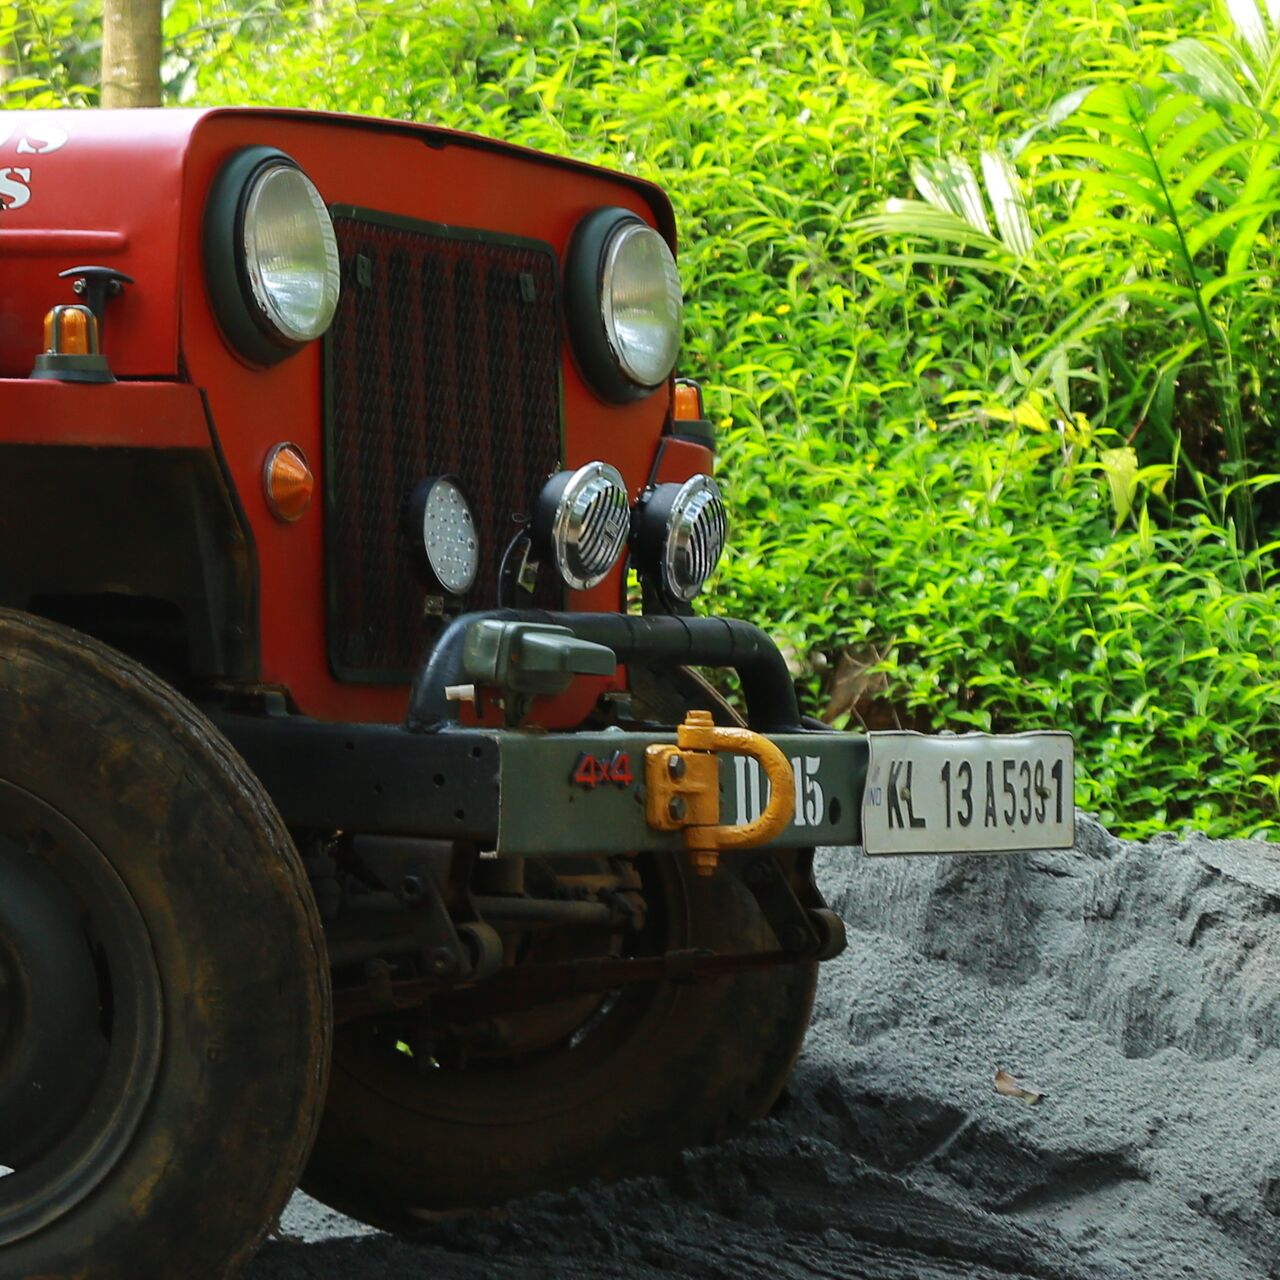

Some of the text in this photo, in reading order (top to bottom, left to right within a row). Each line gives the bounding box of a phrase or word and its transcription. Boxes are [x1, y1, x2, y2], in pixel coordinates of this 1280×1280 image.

[574, 753, 635, 789] 4x4
[886, 760, 927, 829] KL
[940, 760, 974, 829] 13
